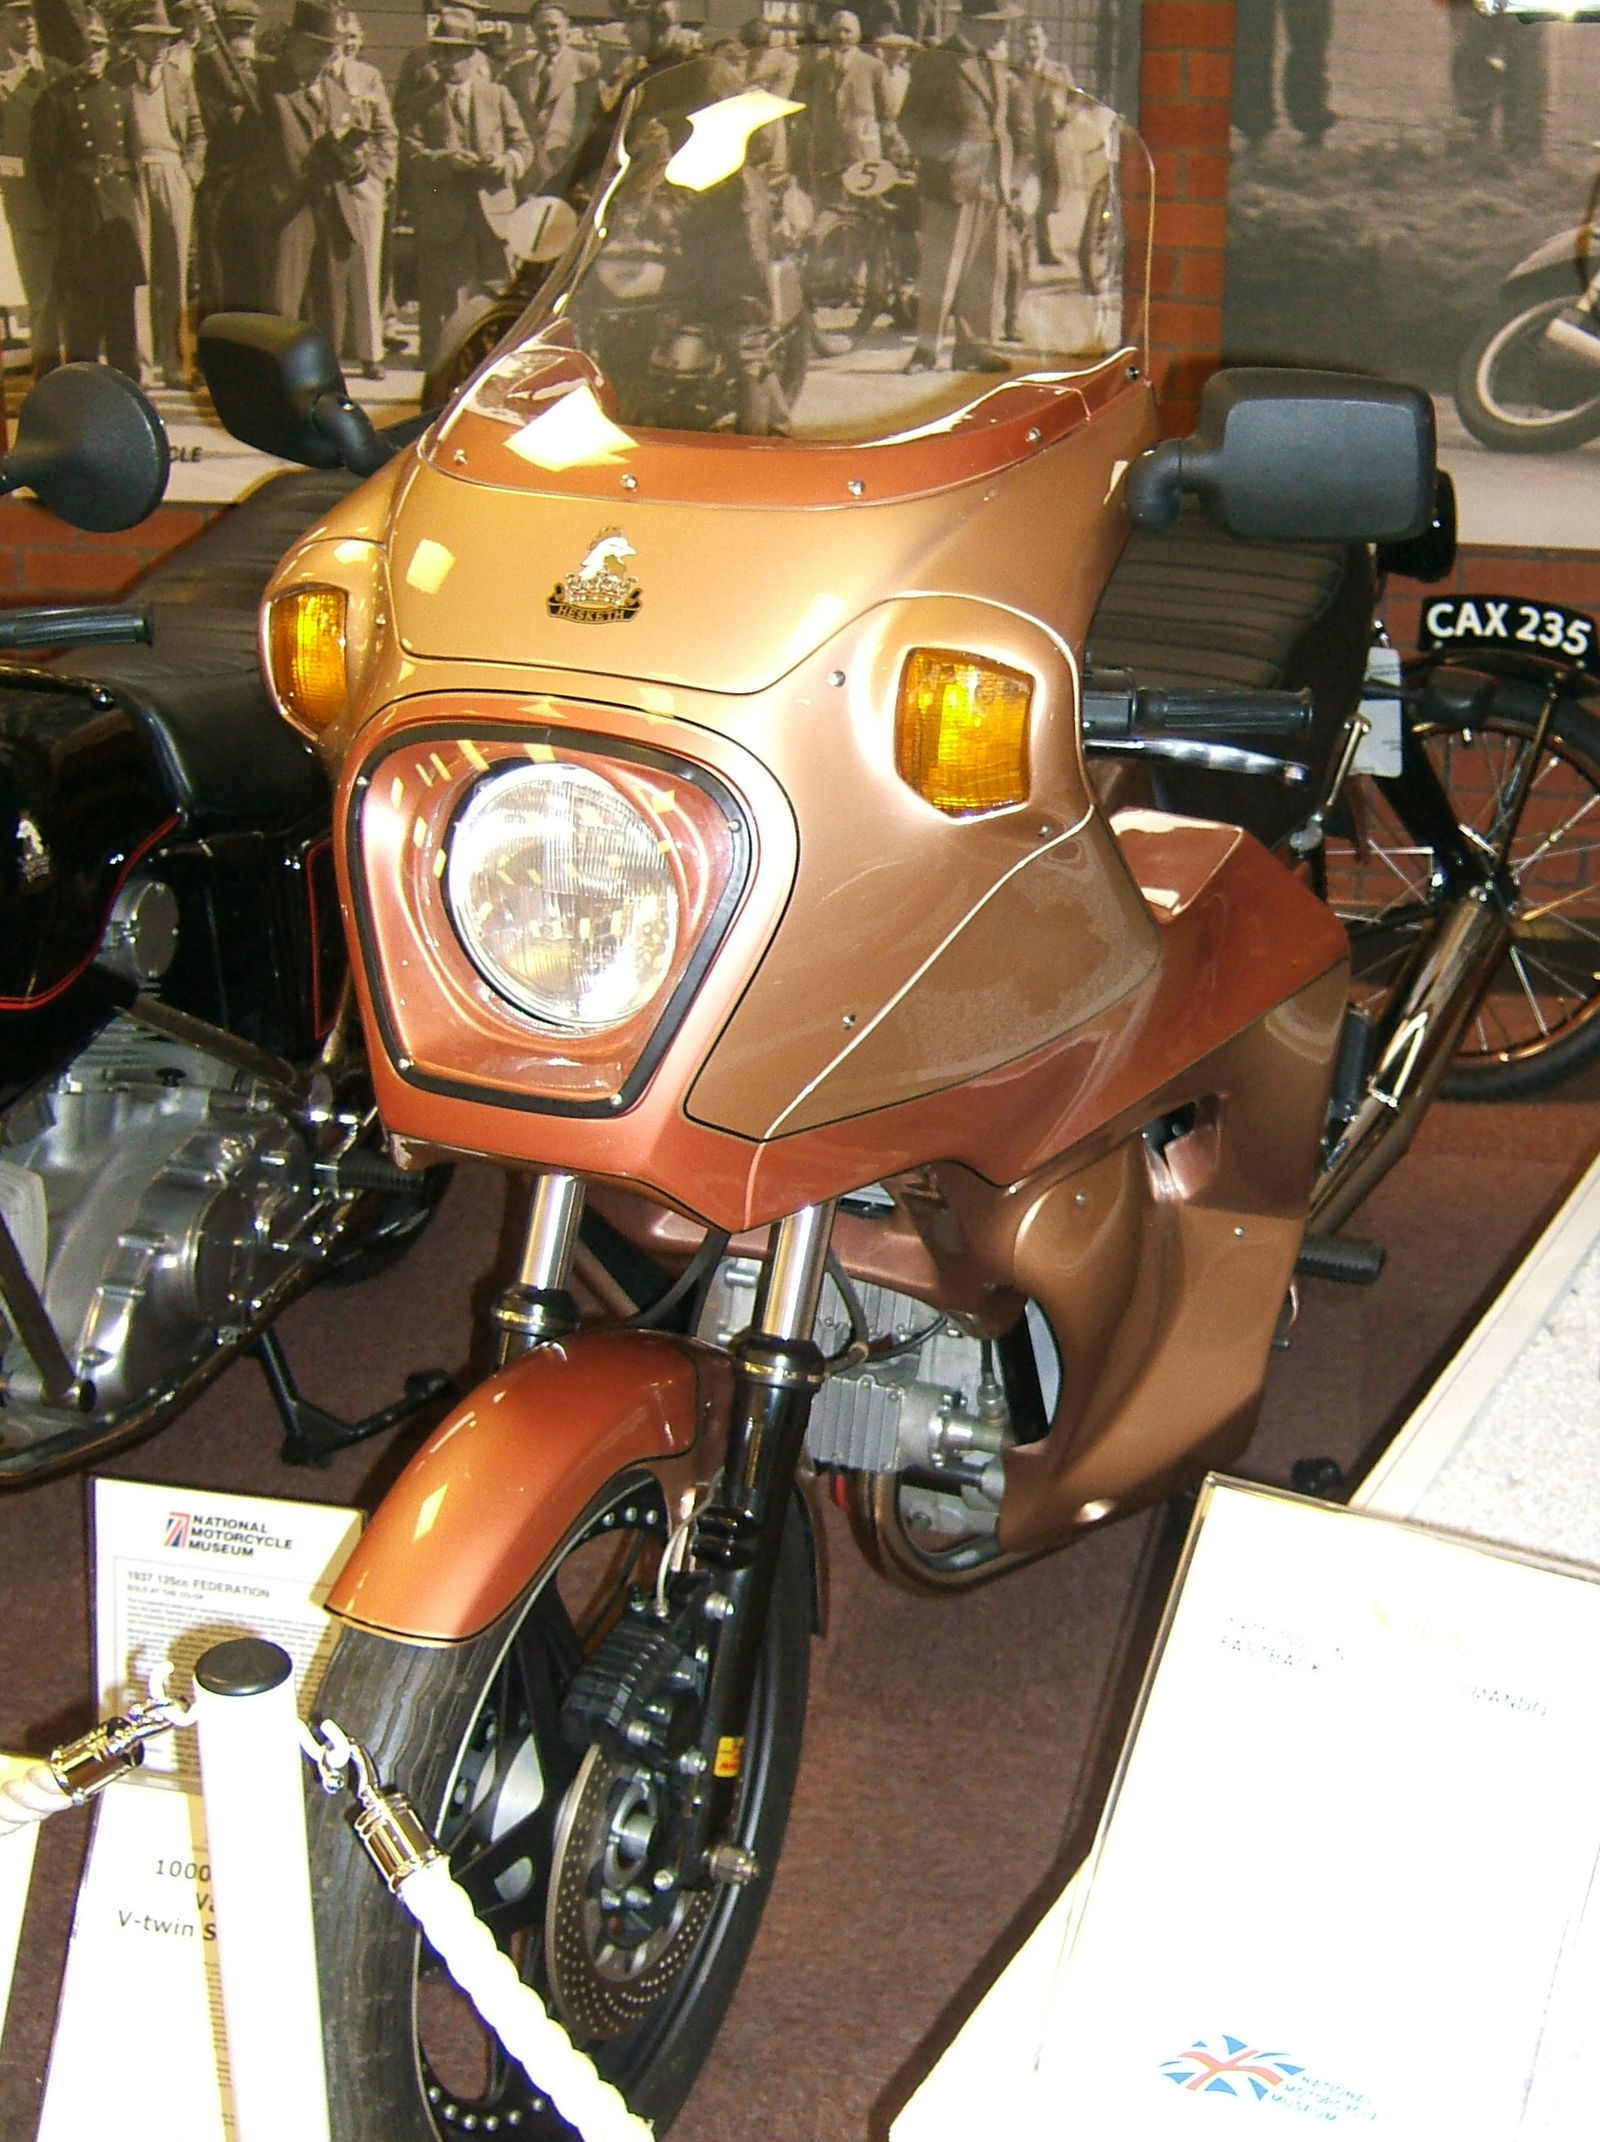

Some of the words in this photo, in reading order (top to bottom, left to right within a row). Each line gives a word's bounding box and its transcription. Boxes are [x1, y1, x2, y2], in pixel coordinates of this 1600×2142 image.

[857, 161, 881, 191] 5
[559, 603, 624, 622] HESKETH
[1426, 602, 1509, 638] CAX
[1515, 606, 1592, 656] 235
[193, 1514, 269, 1534] NATIONAL
[188, 1540, 254, 1557] MUSEUM
[191, 1527, 294, 1550] MOTORCYCLE
[193, 1579, 271, 1598] FEDERATION
[119, 1909, 194, 1937] V-twin
